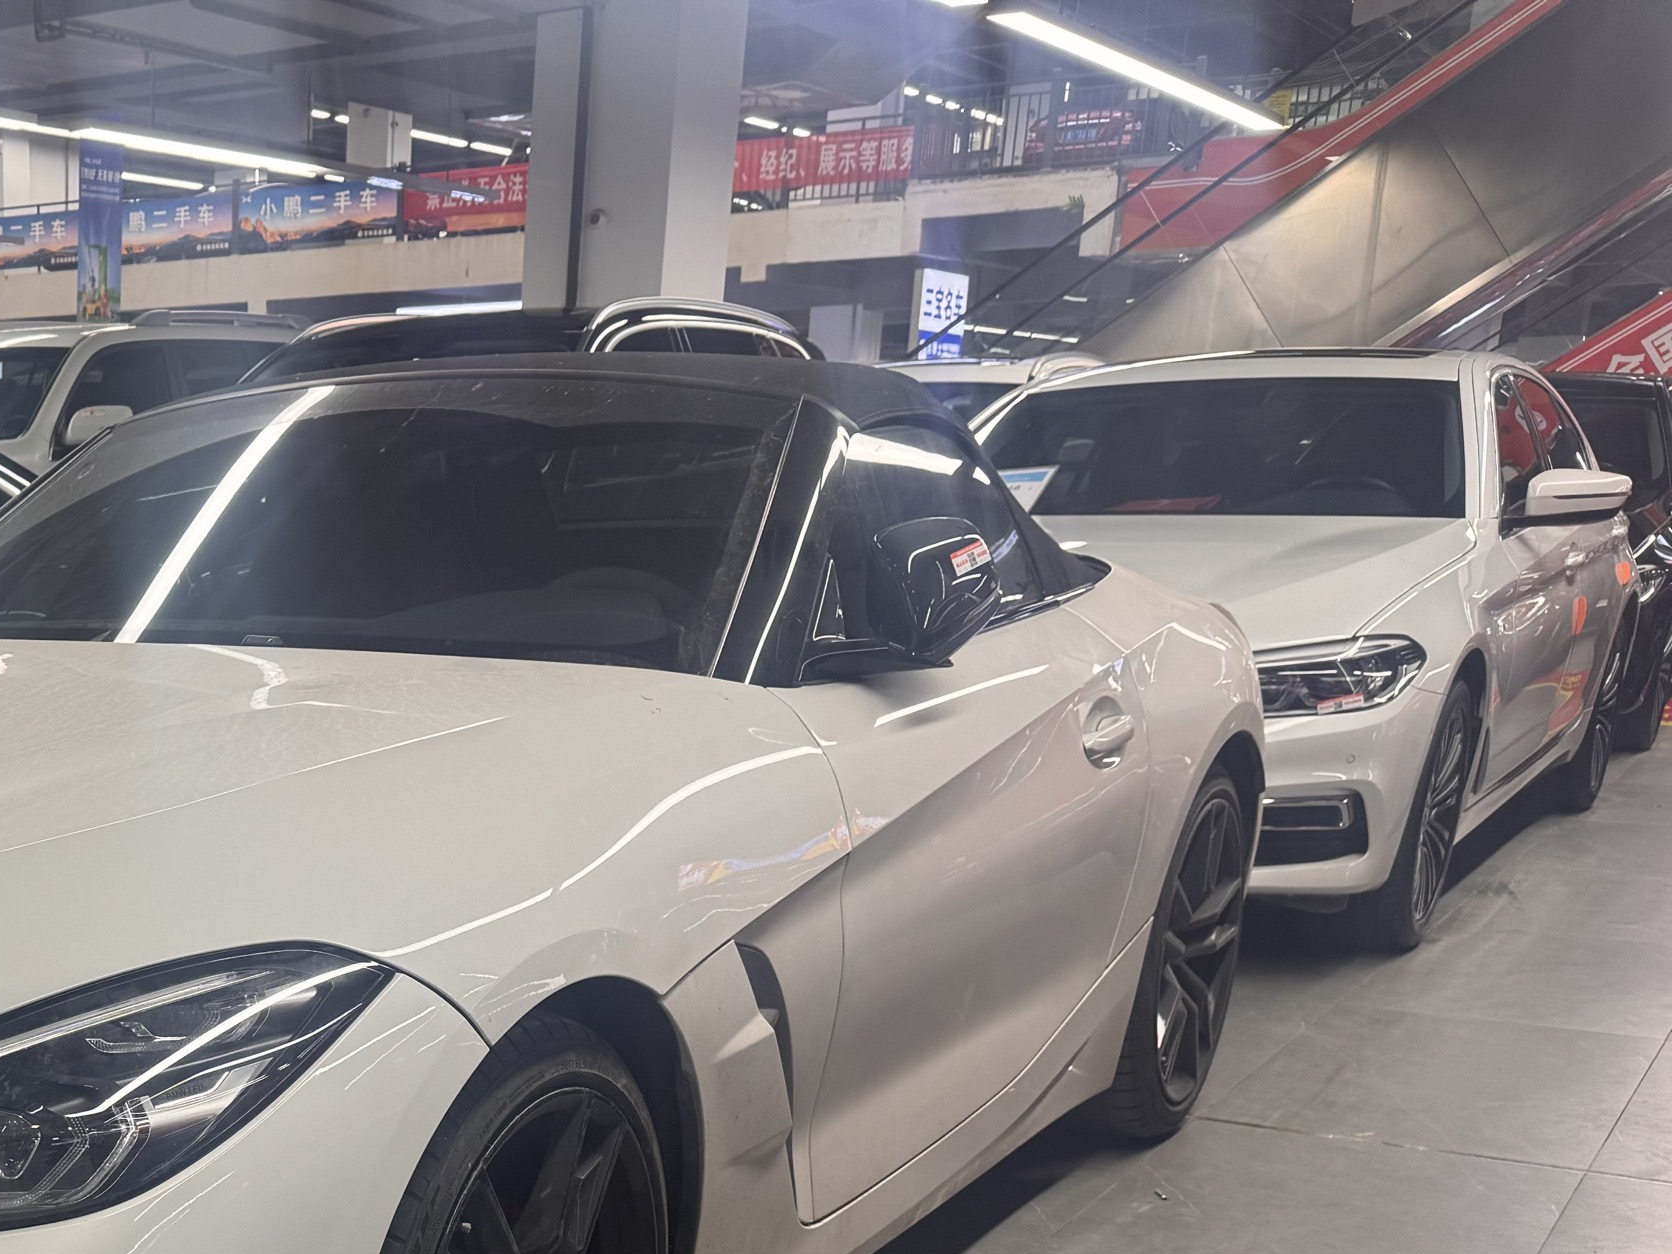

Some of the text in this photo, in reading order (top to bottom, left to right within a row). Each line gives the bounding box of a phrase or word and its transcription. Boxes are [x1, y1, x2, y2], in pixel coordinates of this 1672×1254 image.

[734, 136, 914, 182] 、经纪、展示等服务
[259, 188, 378, 220] 小鹏二手车
